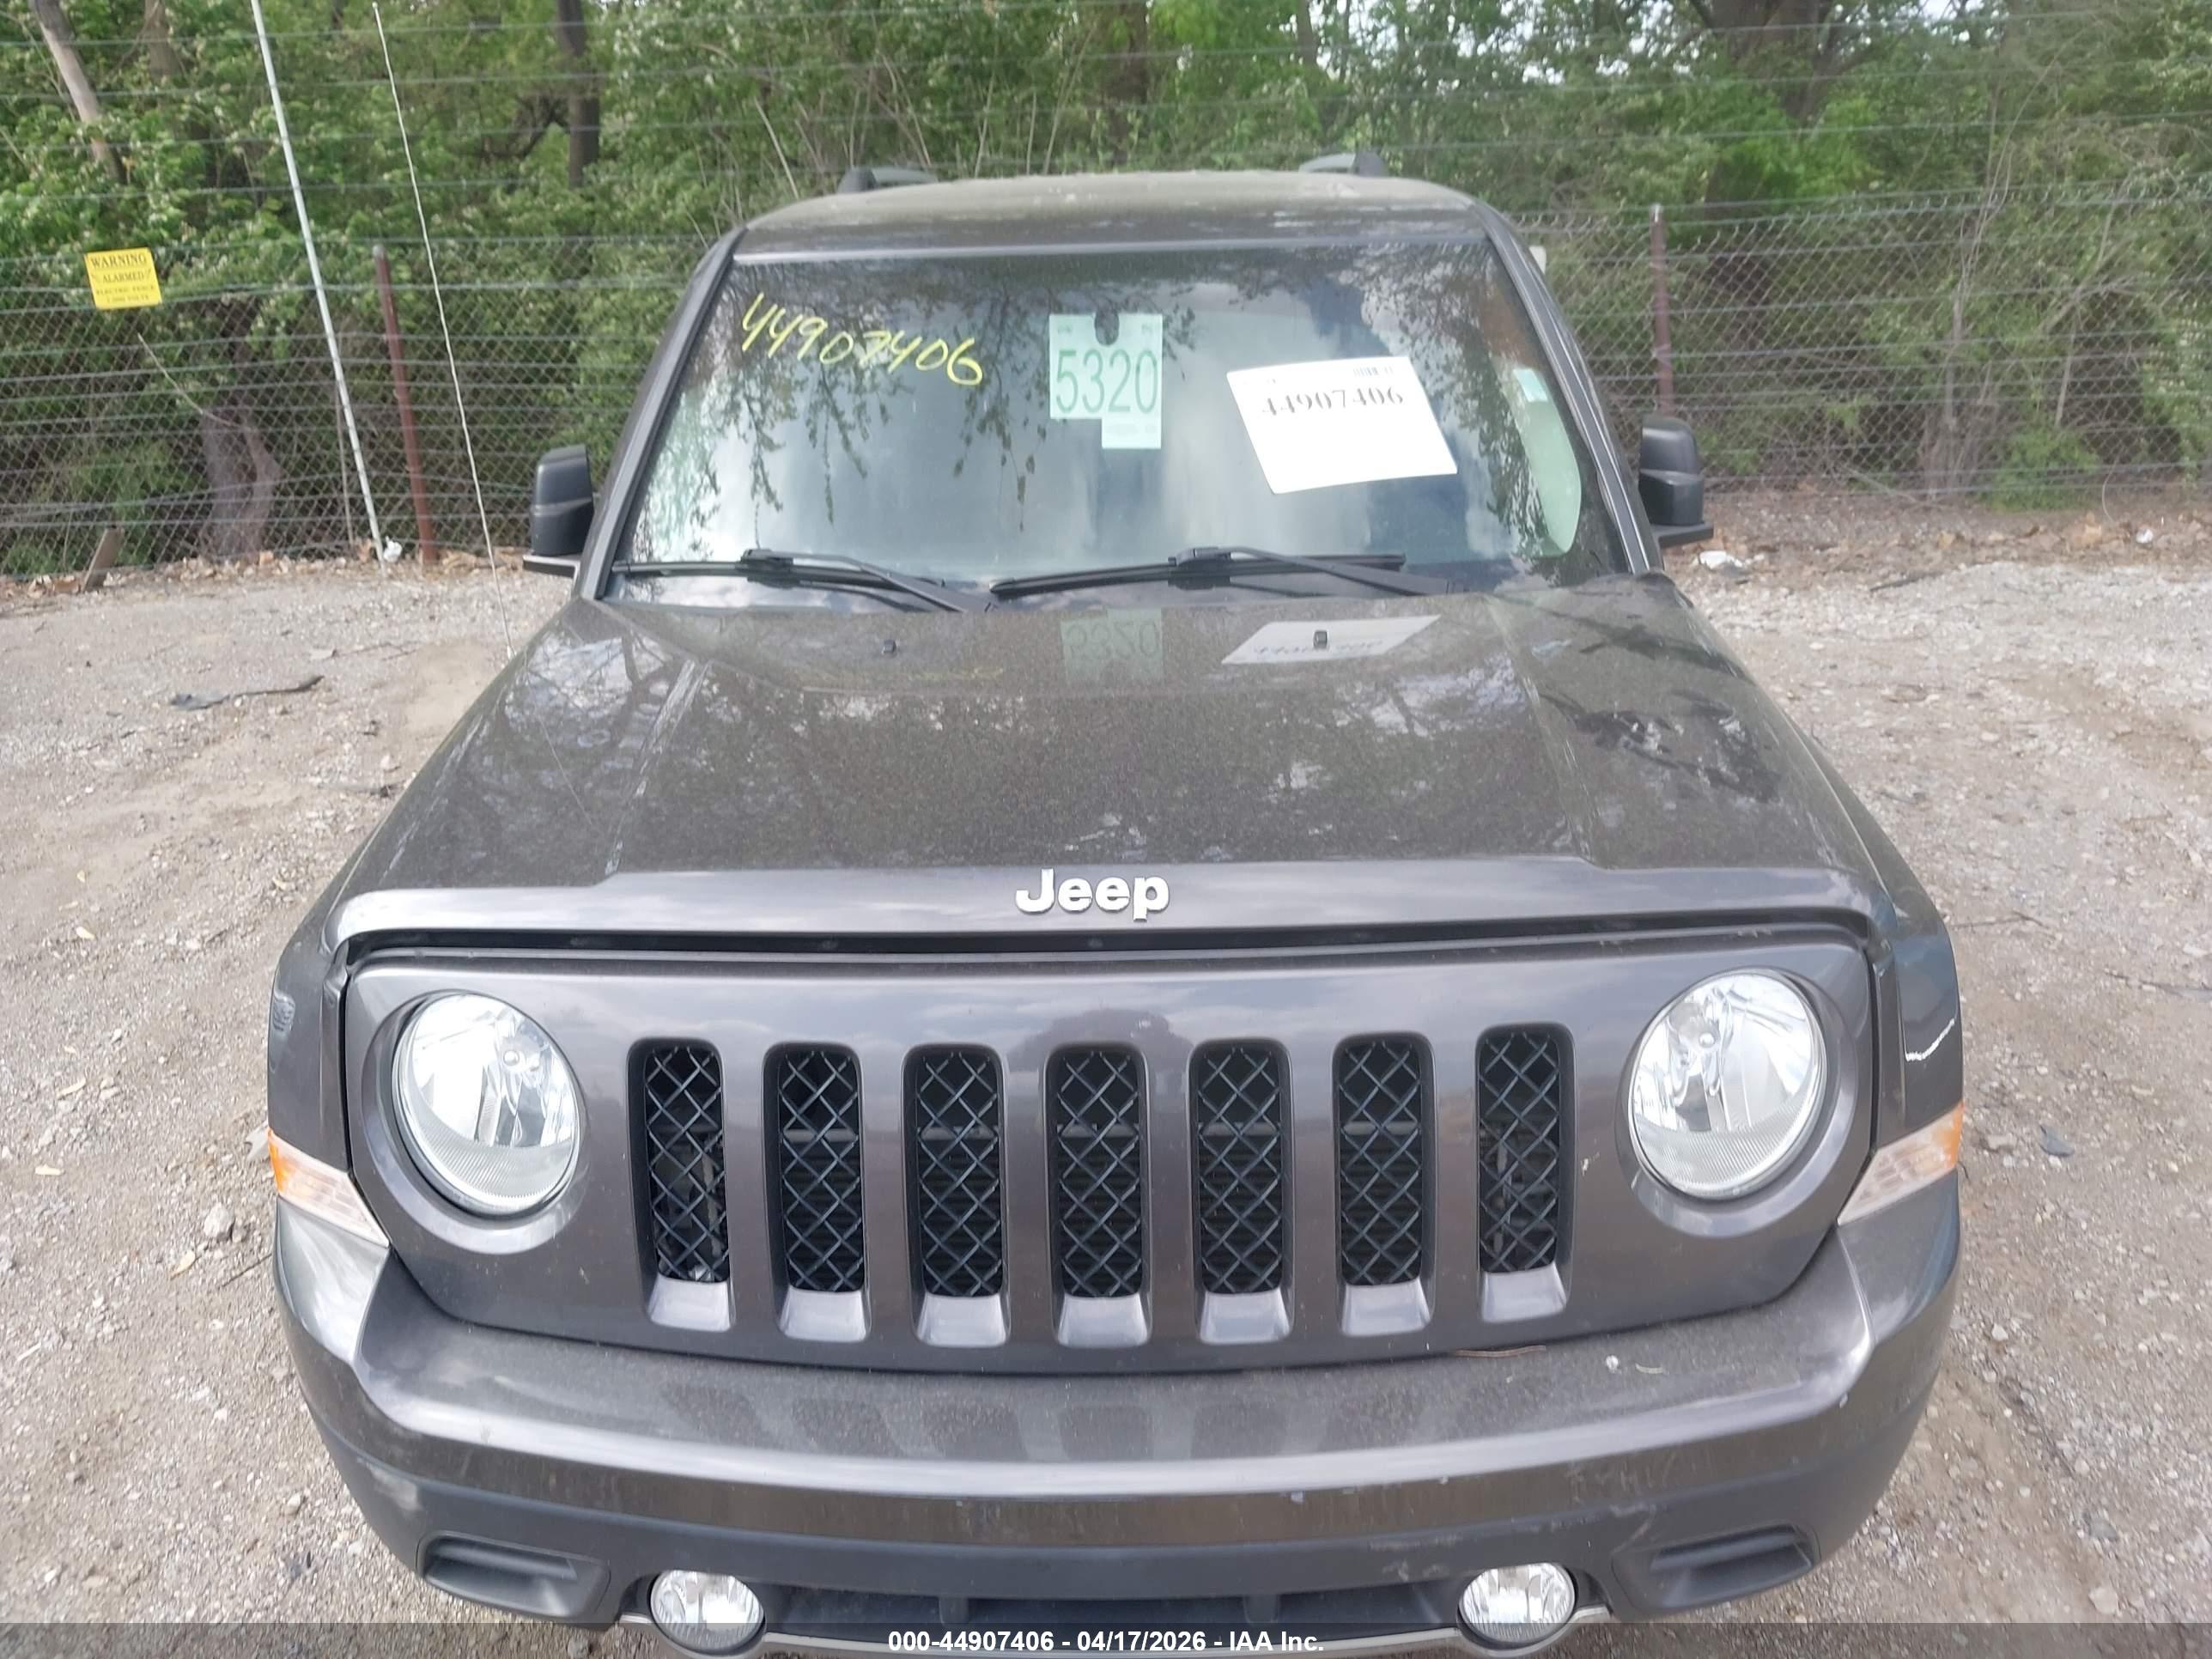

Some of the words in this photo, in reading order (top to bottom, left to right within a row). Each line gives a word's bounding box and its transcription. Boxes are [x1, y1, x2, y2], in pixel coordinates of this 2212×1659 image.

[91, 252, 146, 268] WARNING
[102, 272, 144, 283] ALARMED
[742, 292, 983, 386] 44907406
[1056, 349, 1158, 414] 5320
[1261, 386, 1404, 416] 44907406
[1016, 867, 1170, 923] Jeep
